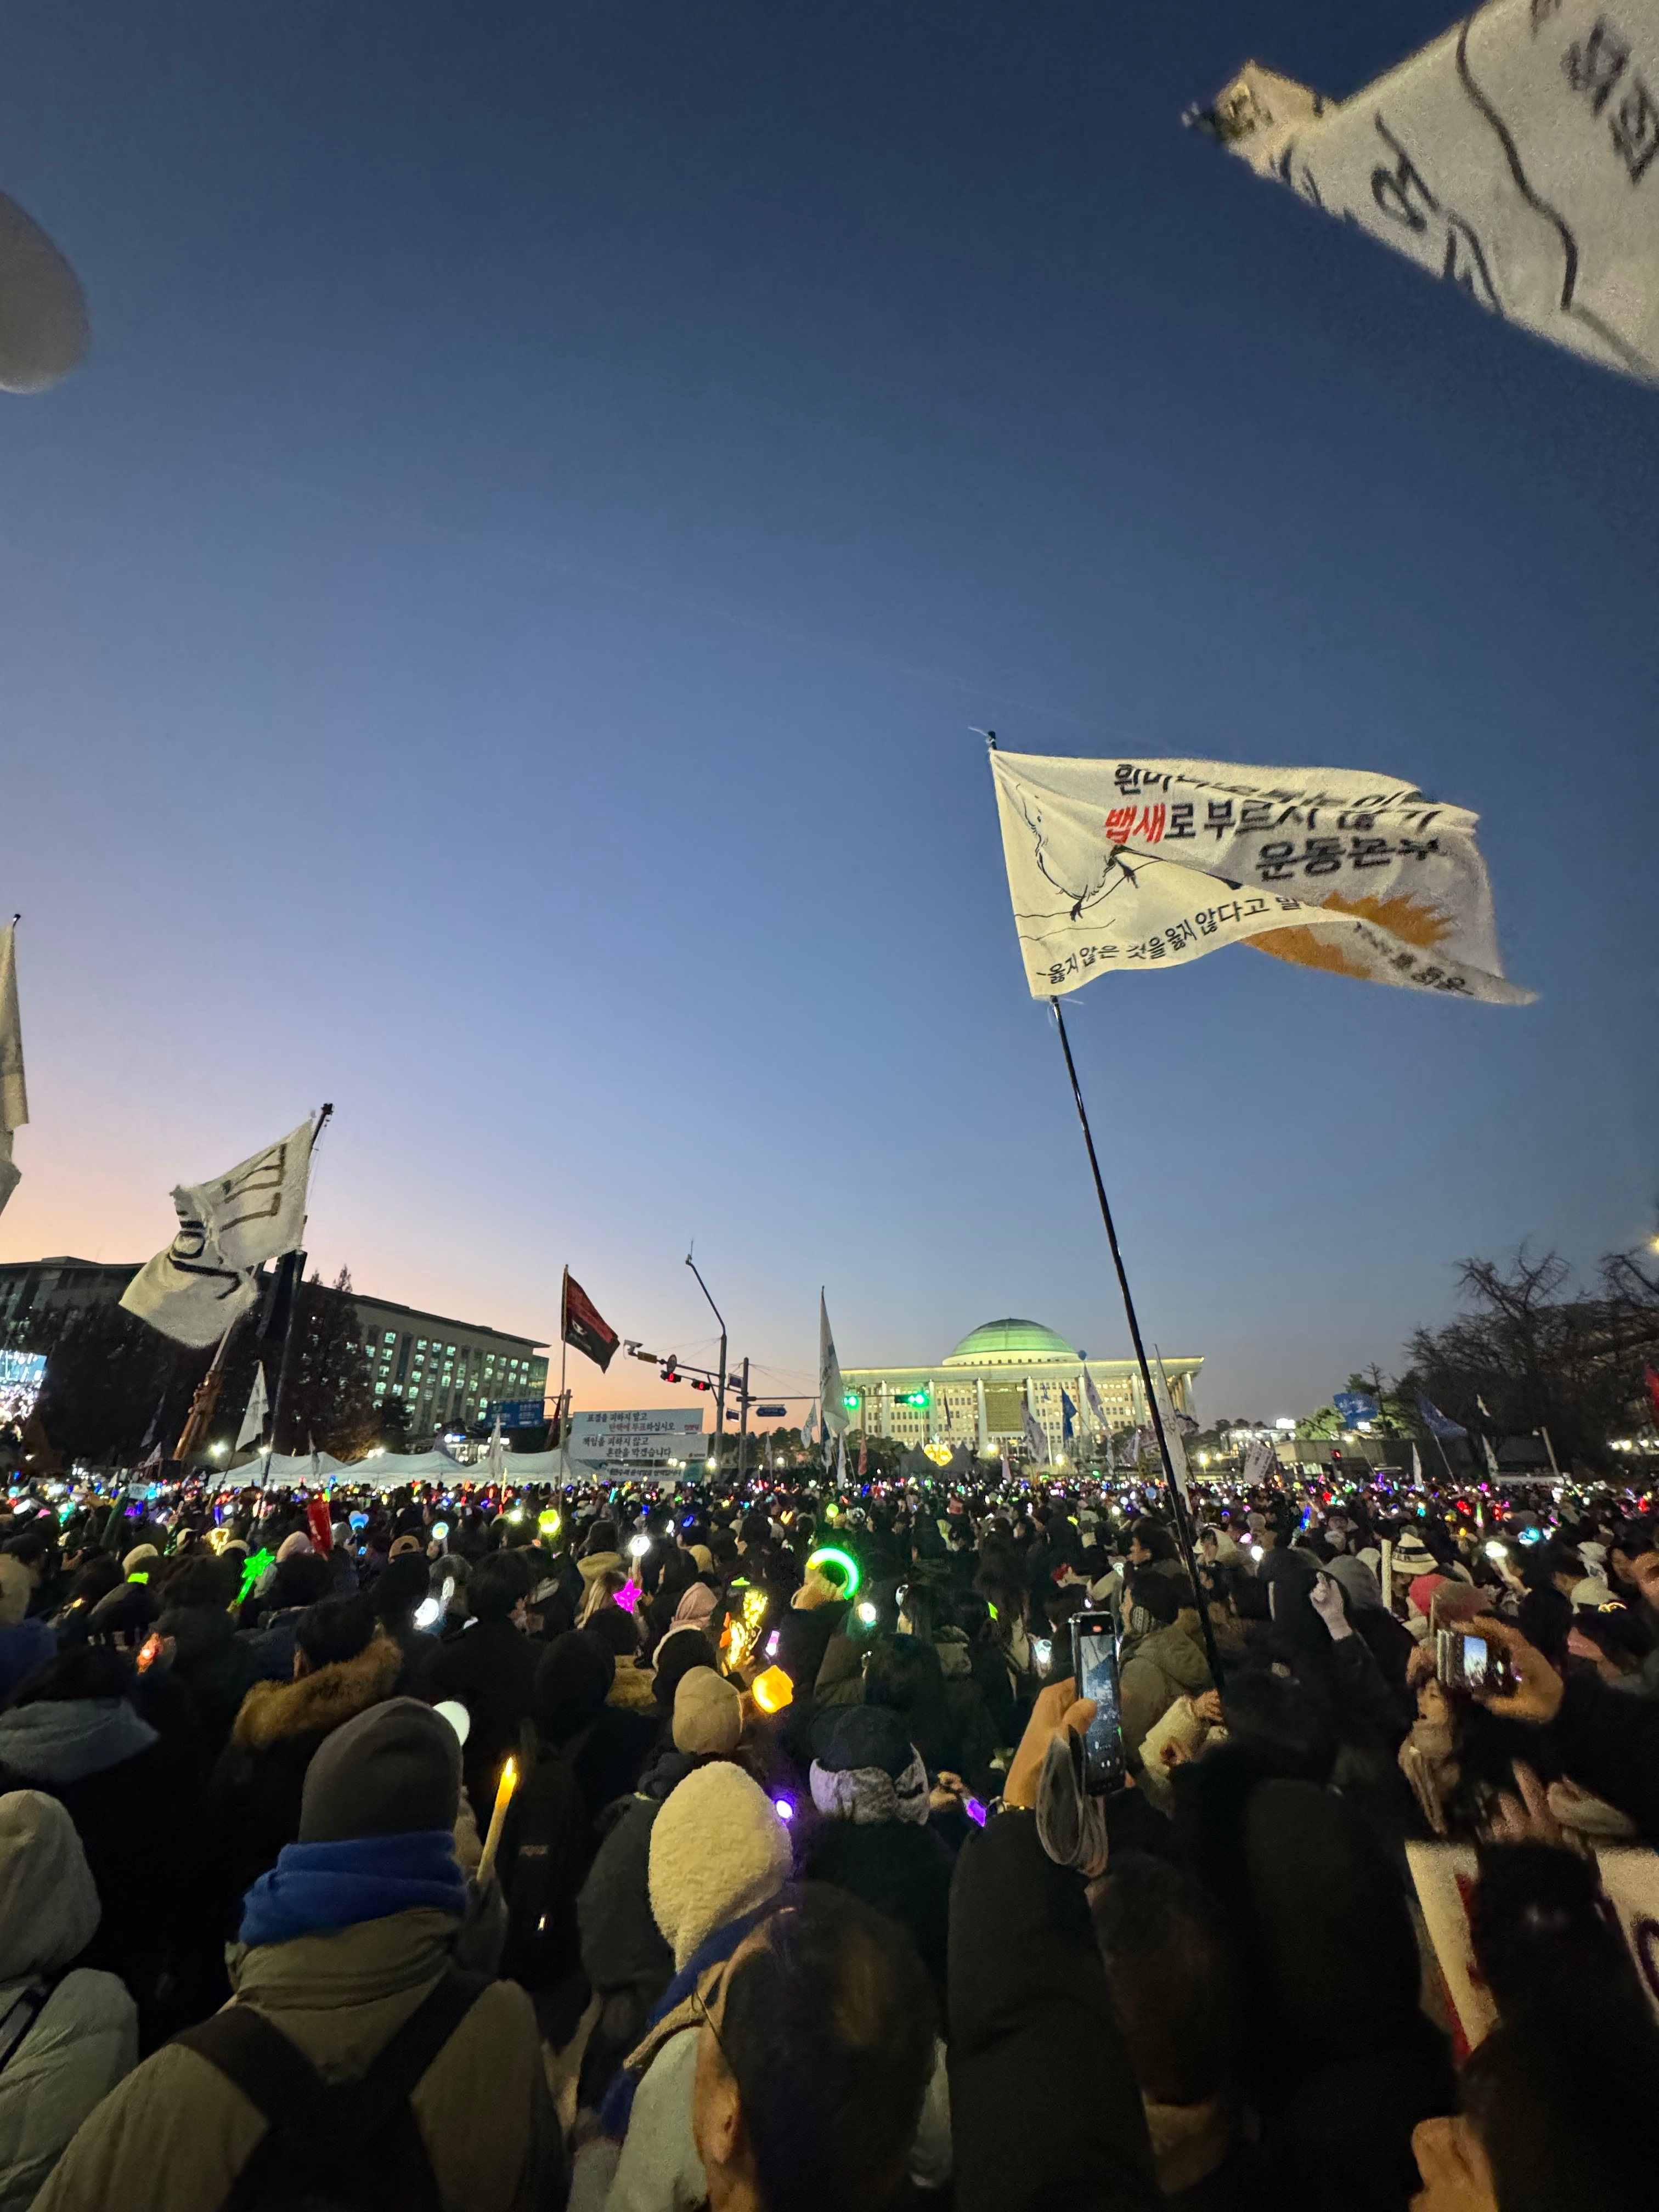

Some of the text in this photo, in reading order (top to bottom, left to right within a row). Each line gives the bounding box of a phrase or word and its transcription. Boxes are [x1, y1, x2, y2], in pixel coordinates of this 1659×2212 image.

[1079, 945, 1120, 967] 않은
[1126, 935, 1166, 960] 것을
[1165, 918, 1197, 951] 옳지
[1195, 898, 1271, 936] 않다고
[586, 1412, 648, 1423] 표결을 피하지 말고
[631, 1421, 676, 1432] 투표하십시오
[583, 1436, 649, 1447] 책임을 피하지 않고
[606, 1447, 672, 1458] 혼란을 막겠습니다
